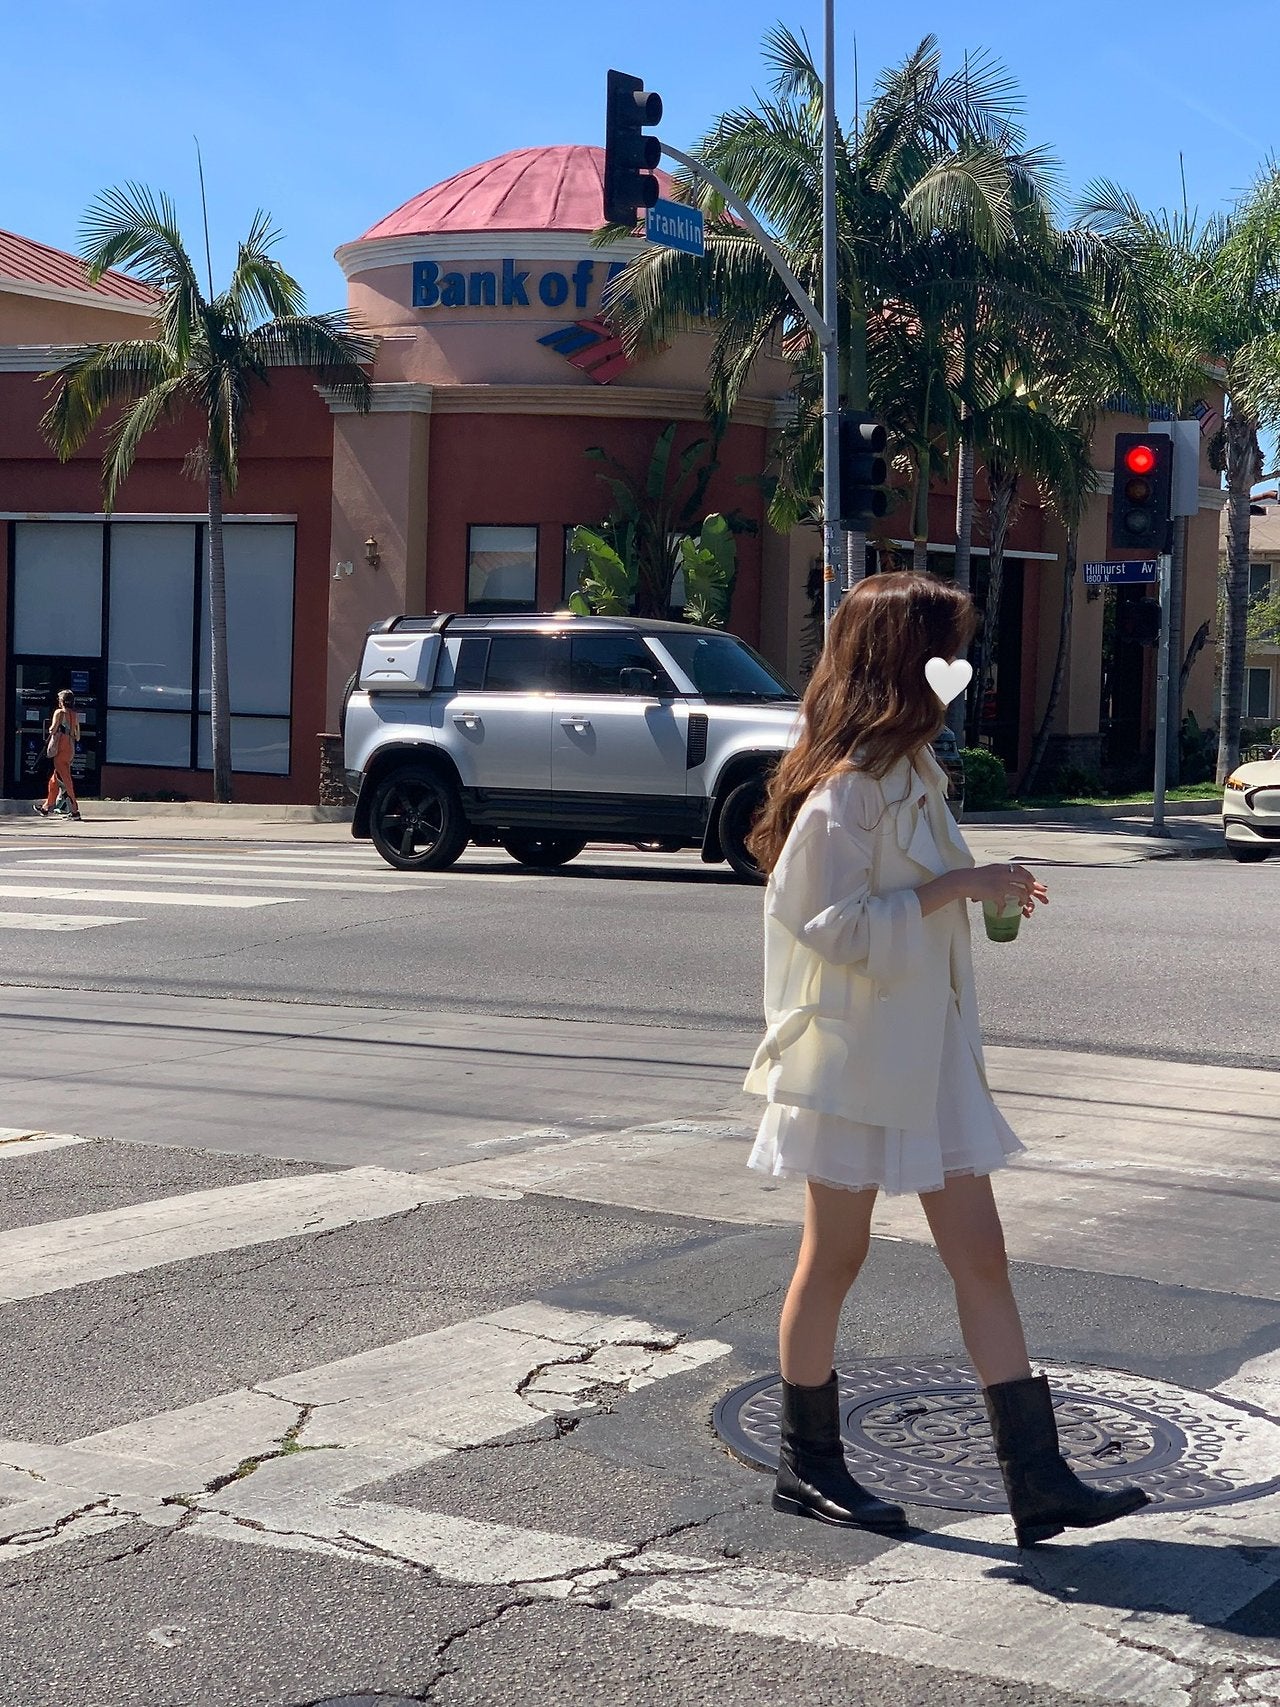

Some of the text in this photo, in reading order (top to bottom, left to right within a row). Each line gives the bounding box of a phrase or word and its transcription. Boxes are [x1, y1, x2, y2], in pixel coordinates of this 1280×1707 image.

[648, 209, 702, 244] Franklin
[412, 258, 529, 308] Bank
[538, 259, 594, 308] of
[1086, 562, 1153, 575] Hillhurst Av
[1086, 574, 1102, 583] 1800
